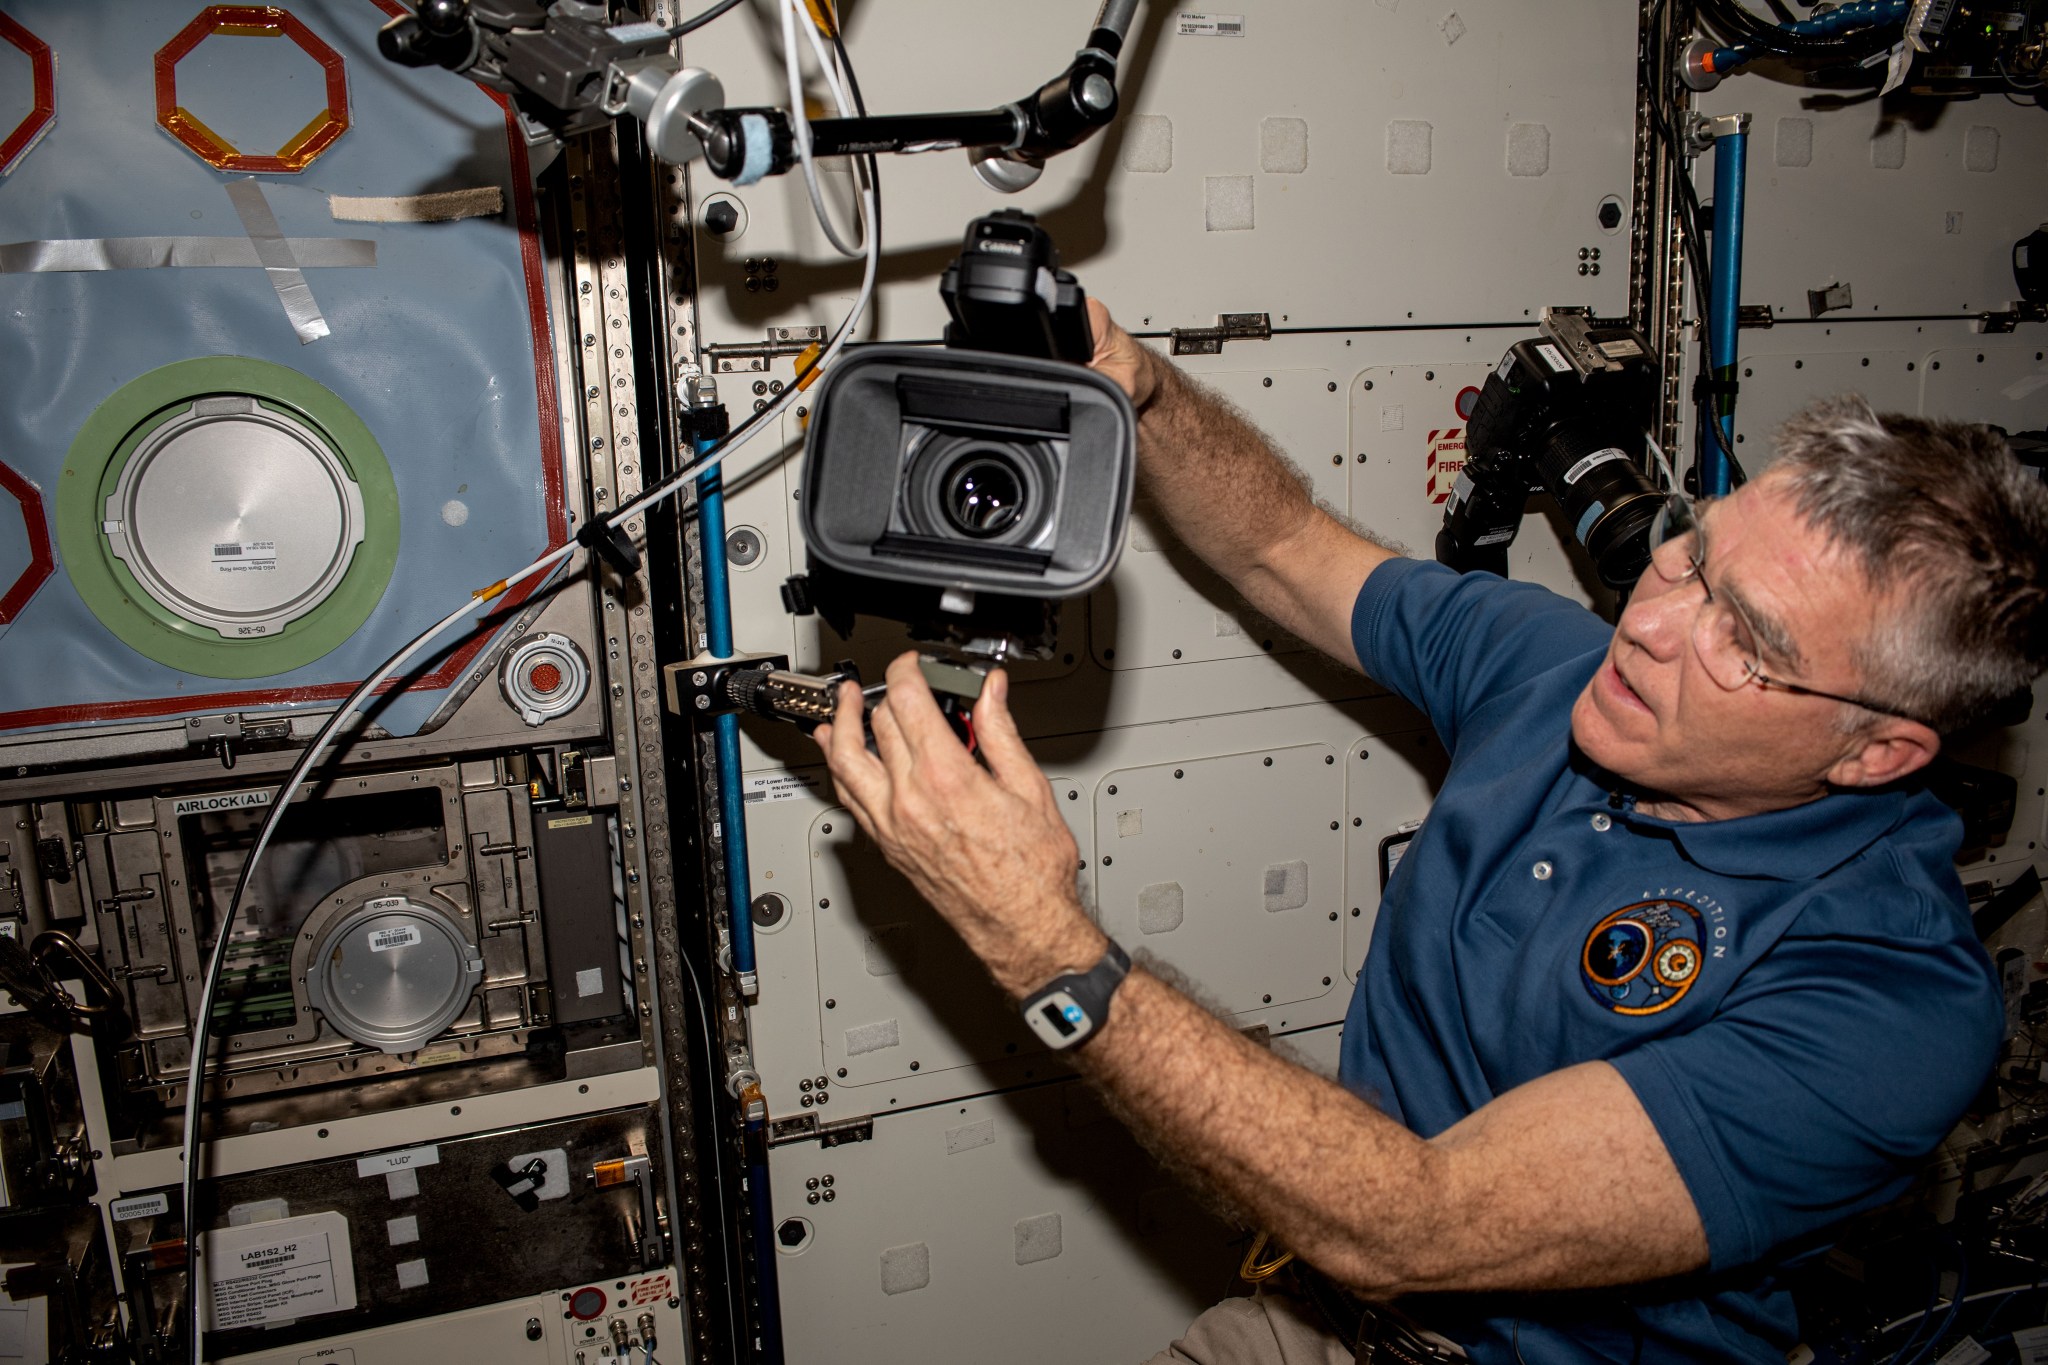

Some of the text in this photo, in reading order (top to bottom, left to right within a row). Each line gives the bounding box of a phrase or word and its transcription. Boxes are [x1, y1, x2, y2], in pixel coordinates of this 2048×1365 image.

[979, 240, 1022, 256] Canon
[1439, 461, 1464, 472] FIRE
[238, 626, 266, 634] 05-326
[386, 1155, 411, 1166] "LUD"
[120, 1207, 159, 1218] 00005121K
[241, 1244, 297, 1261] LAB1S2_H2
[228, 1286, 255, 1295] Conditioner
[250, 1288, 276, 1296] Connectors
[317, 1349, 335, 1357] RPDA
